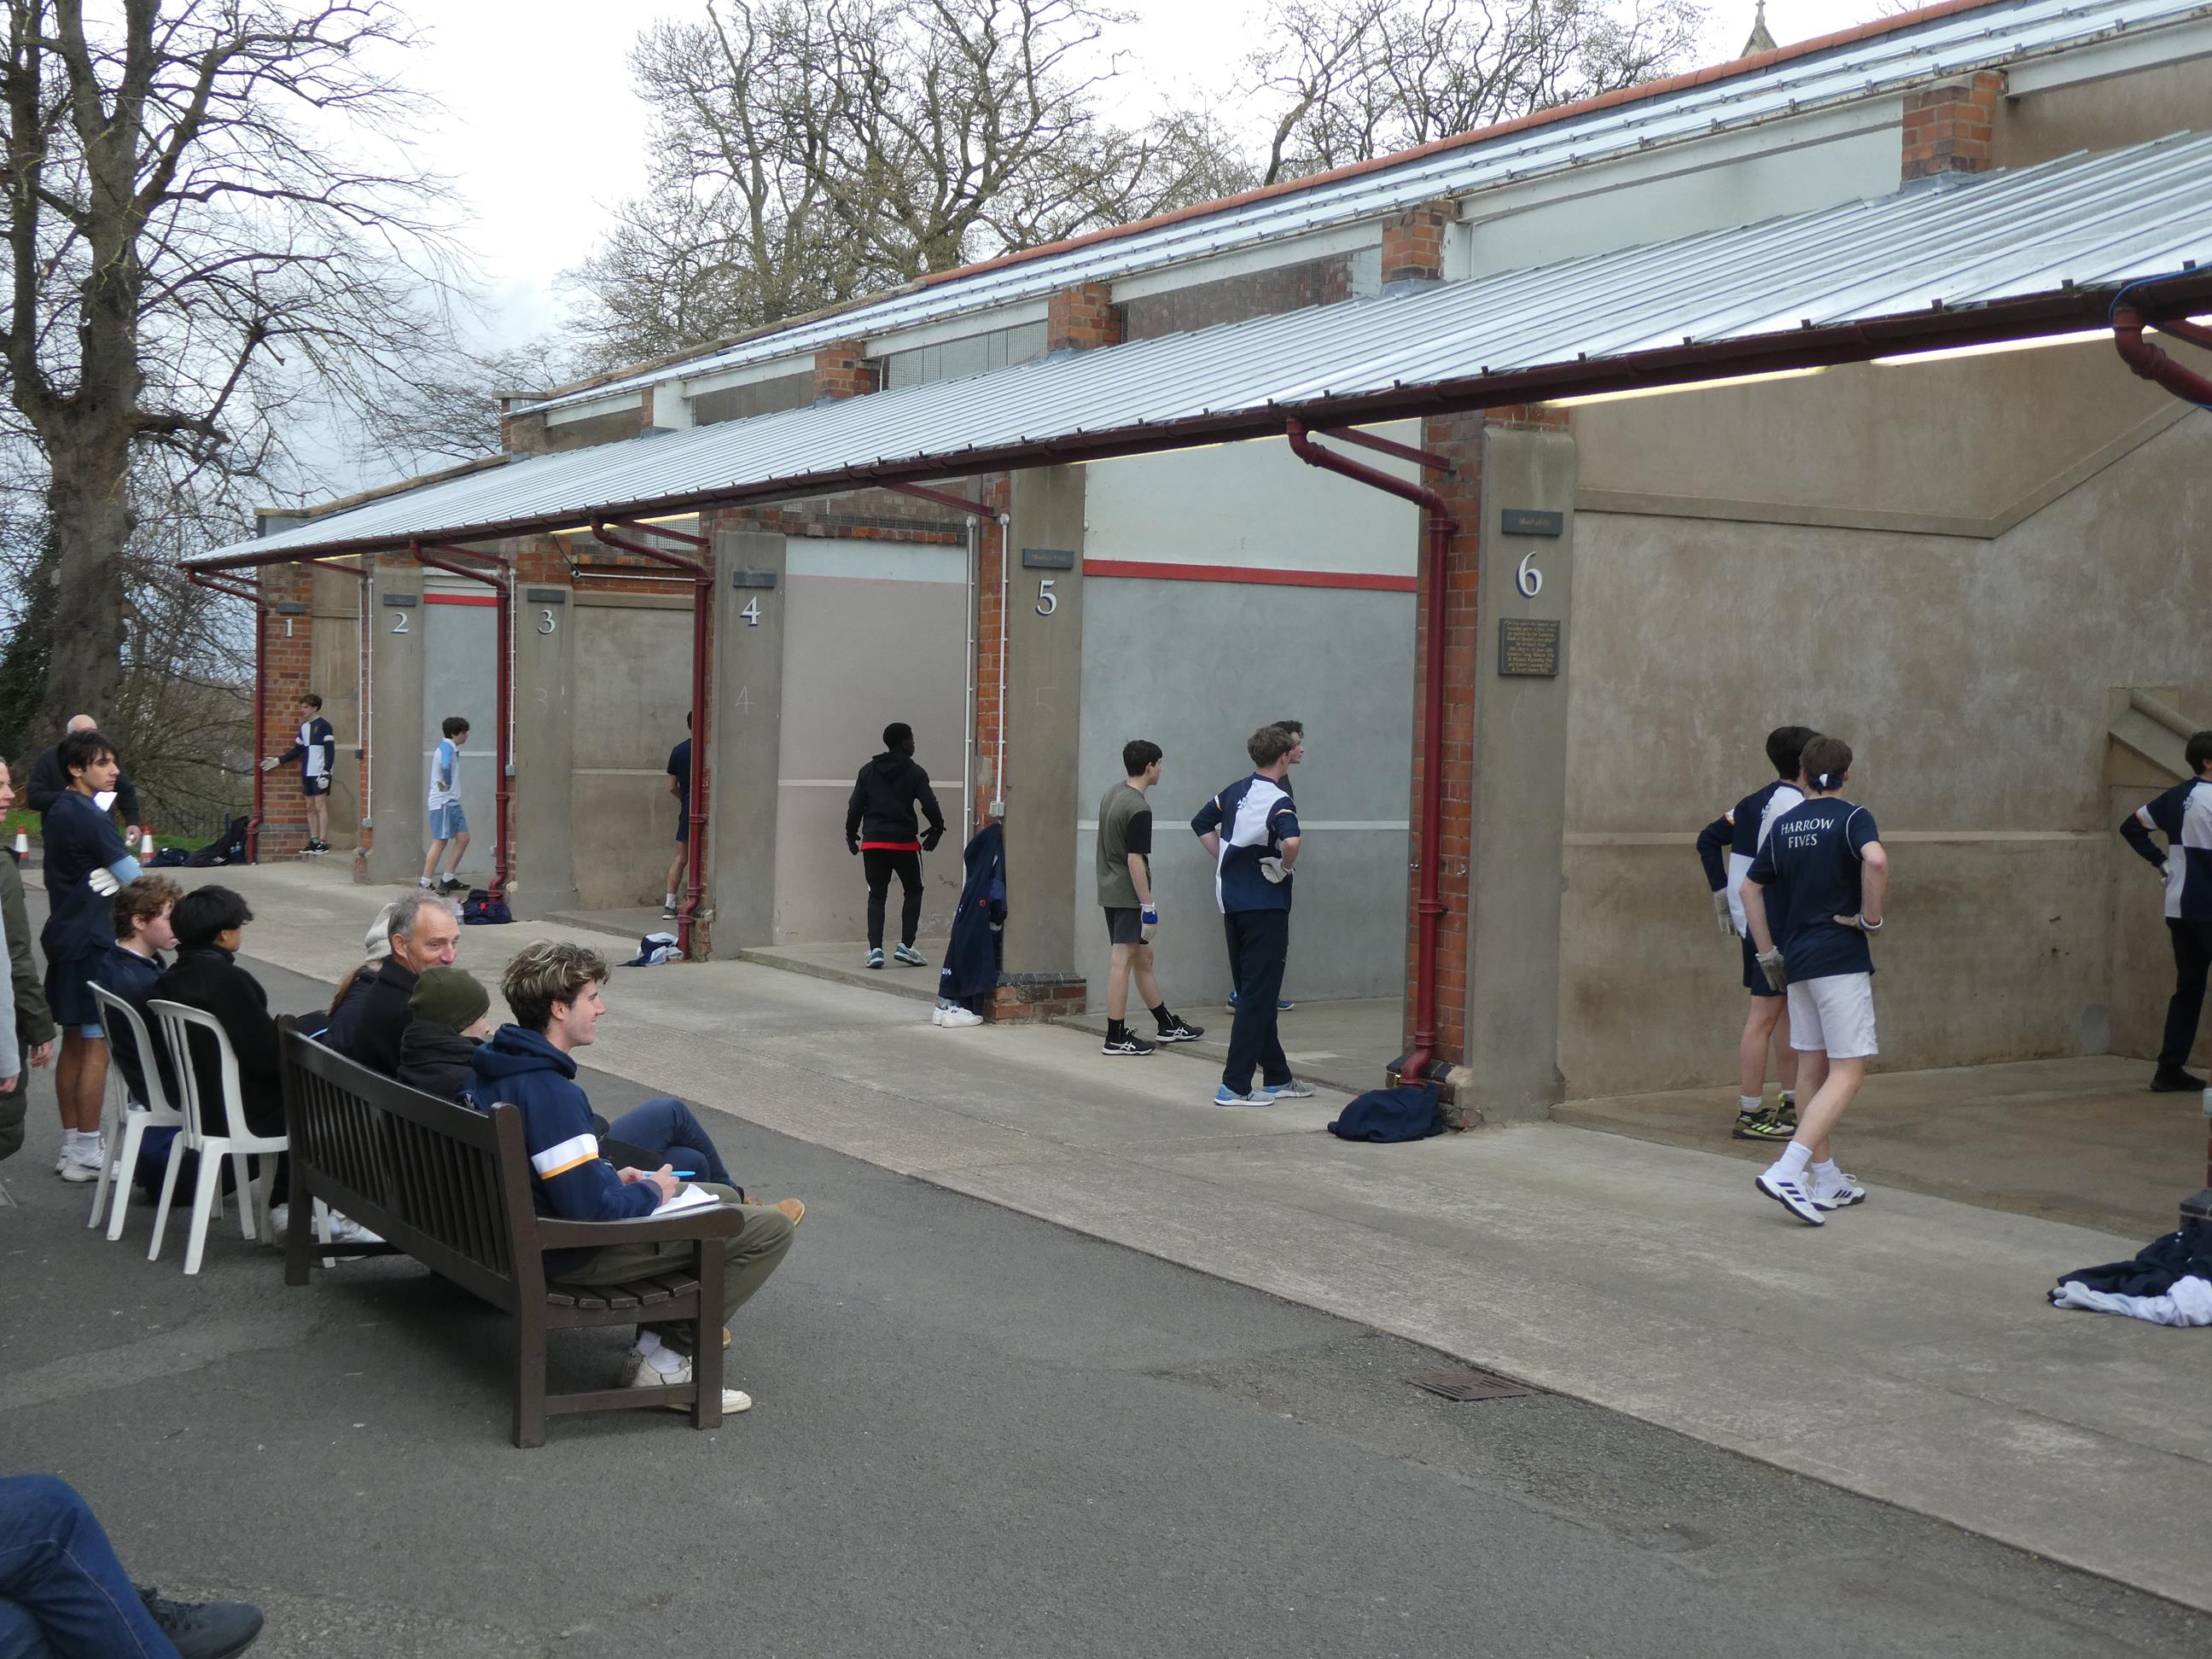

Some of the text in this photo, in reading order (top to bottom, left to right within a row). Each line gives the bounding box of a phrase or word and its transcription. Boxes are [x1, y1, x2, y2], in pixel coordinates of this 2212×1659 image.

[1516, 551, 1542, 598] 6
[1036, 580, 1057, 616] 5
[392, 613, 409, 634] 2
[538, 609, 556, 634] 3
[740, 596, 762, 627] 4
[284, 618, 294, 638] 1
[736, 686, 755, 713] 4
[1781, 818, 1835, 835] HARROW
[1788, 833, 1818, 849] FIVES
